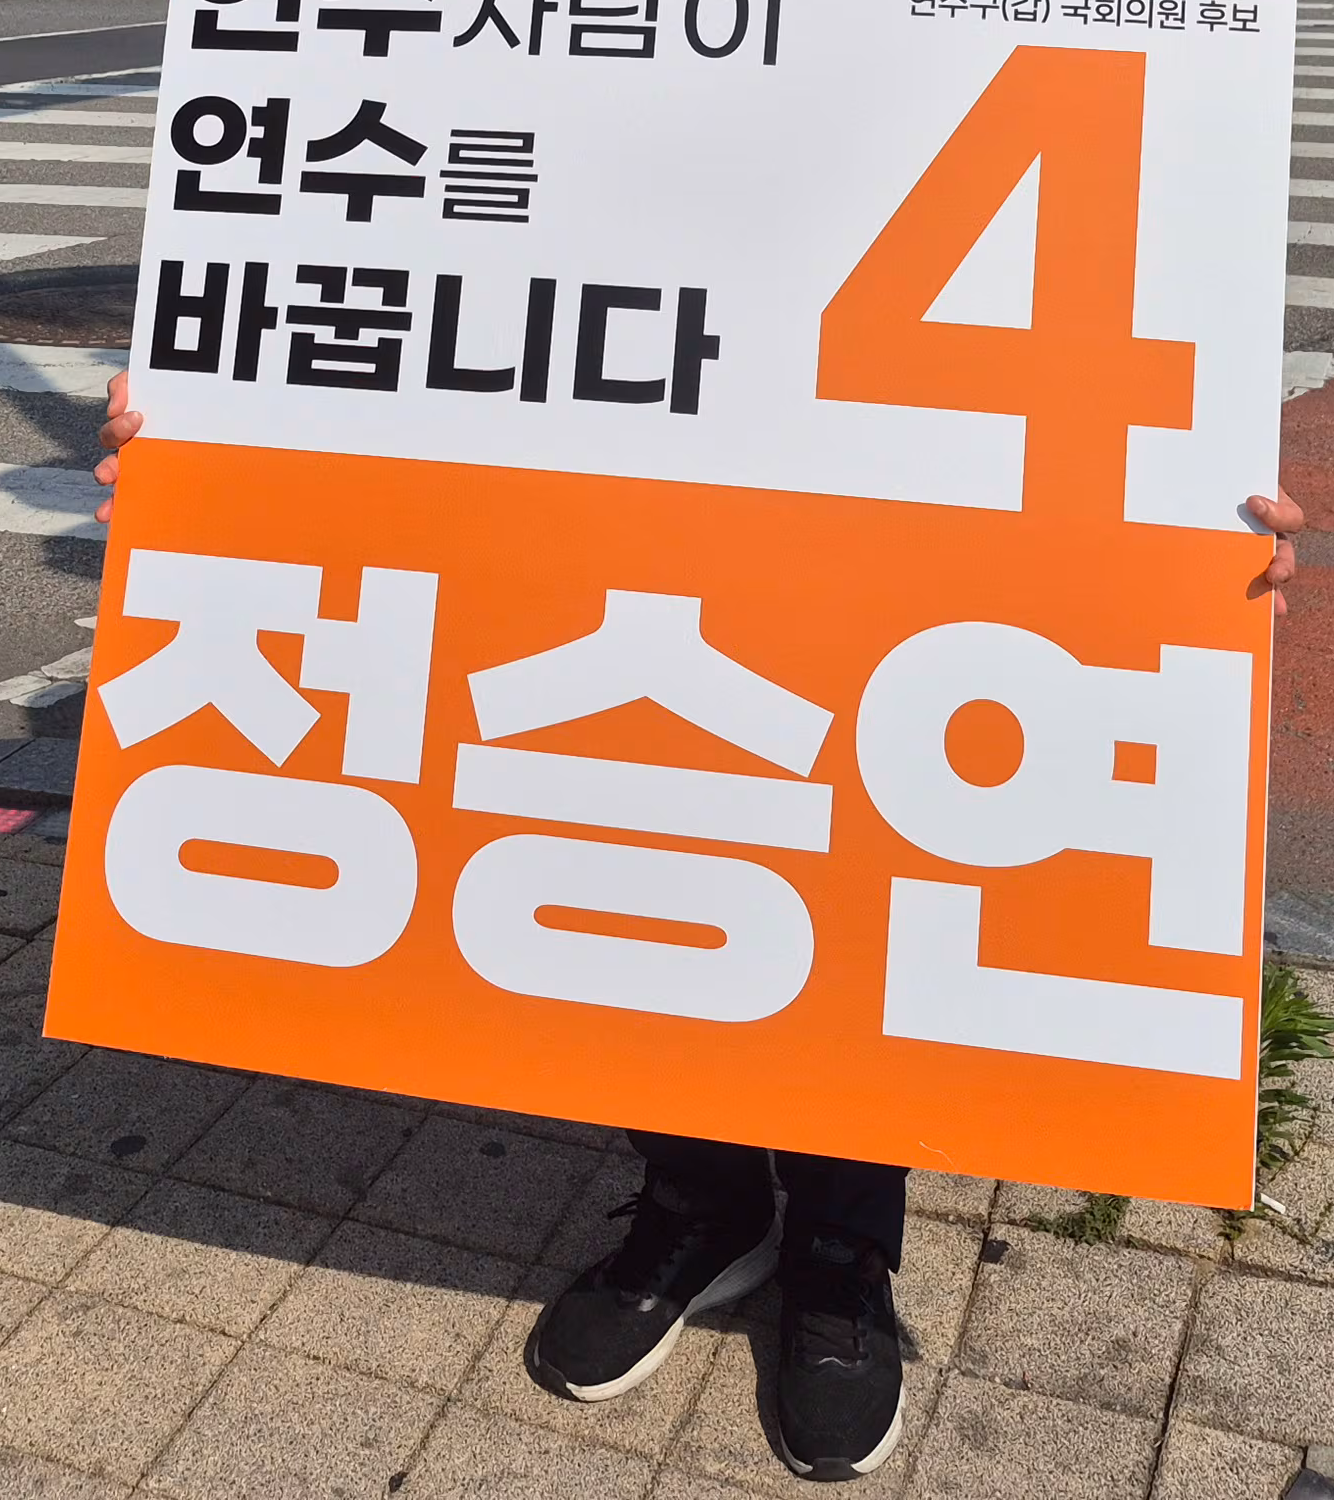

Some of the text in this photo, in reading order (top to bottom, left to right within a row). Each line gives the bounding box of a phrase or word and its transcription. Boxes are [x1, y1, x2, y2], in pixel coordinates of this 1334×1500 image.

[1196, 1, 1260, 33] 후보
[168, 96, 540, 226] 연수를
[149, 260, 720, 416] 바꿉니다
[815, 45, 1196, 522] 4
[97, 548, 1253, 1081] 정승연
